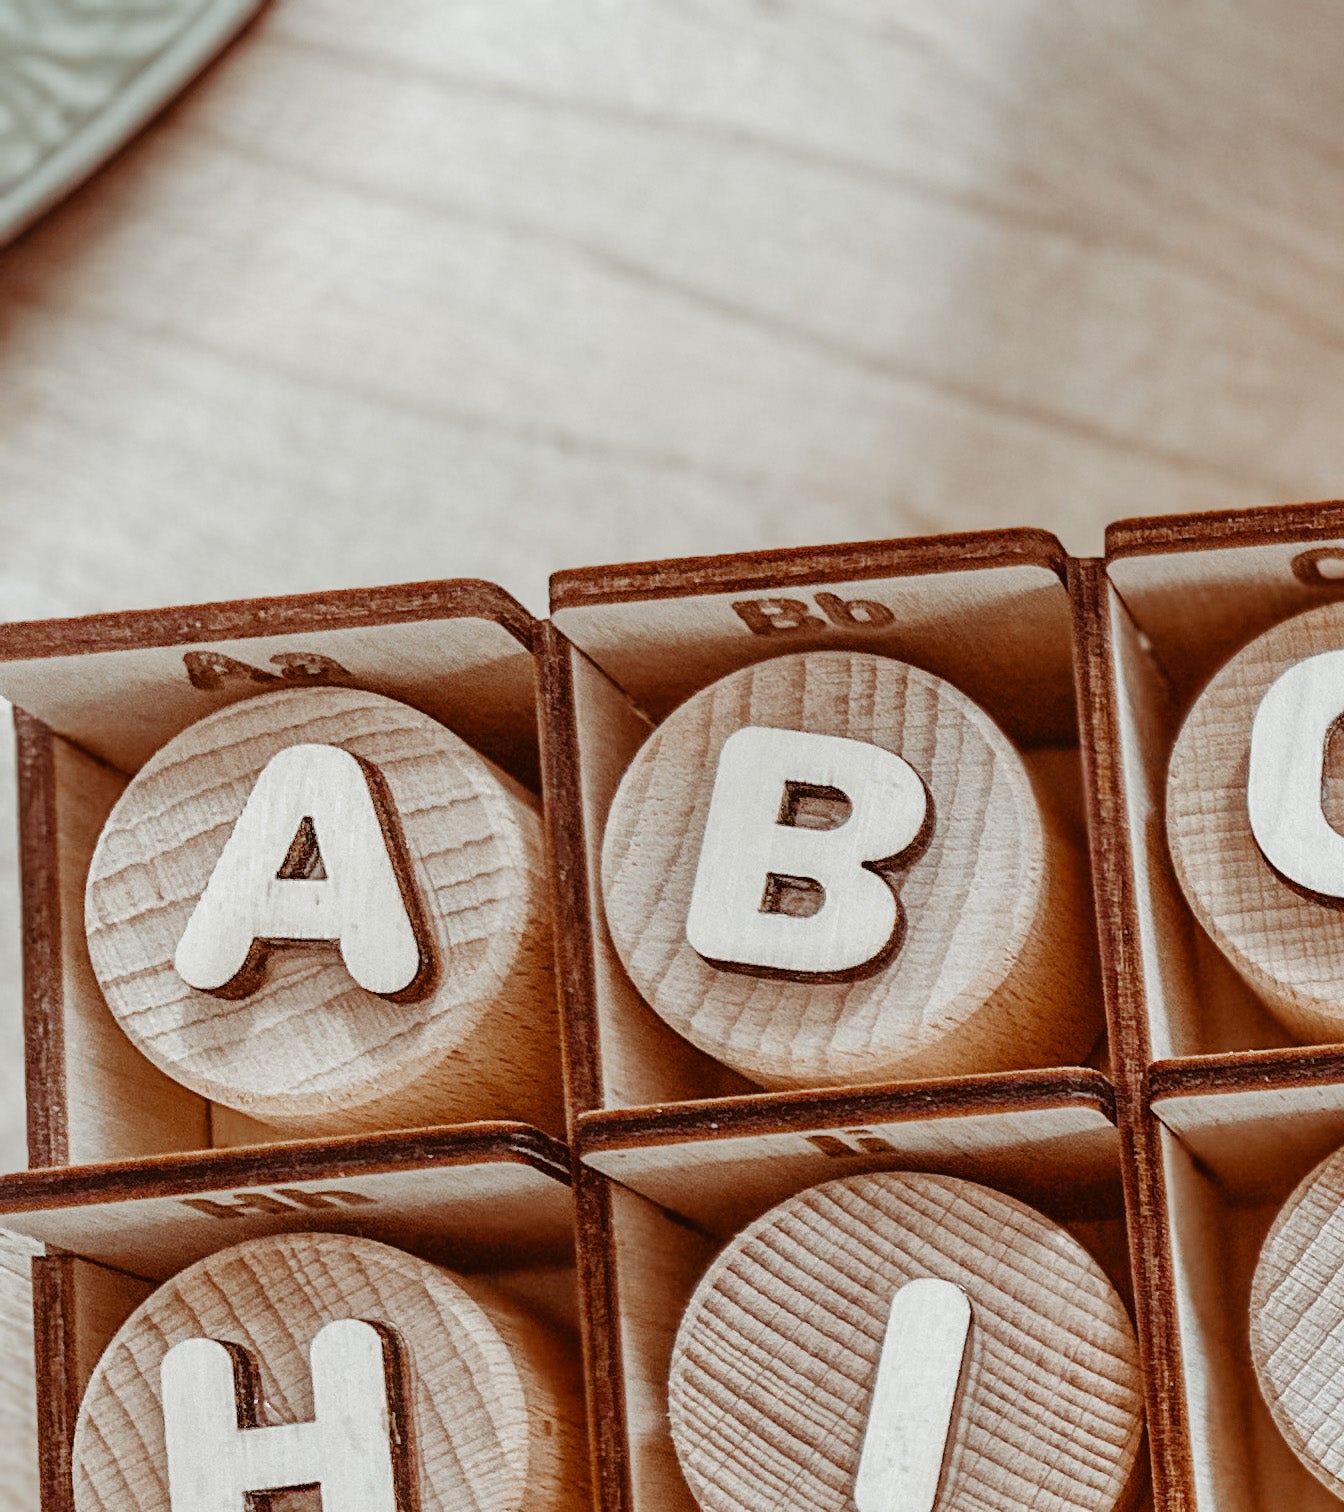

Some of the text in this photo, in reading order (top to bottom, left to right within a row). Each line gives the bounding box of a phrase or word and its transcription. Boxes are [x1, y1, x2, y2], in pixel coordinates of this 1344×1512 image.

[731, 591, 896, 636] Bb
[175, 743, 424, 996] A
[686, 725, 930, 974] B
